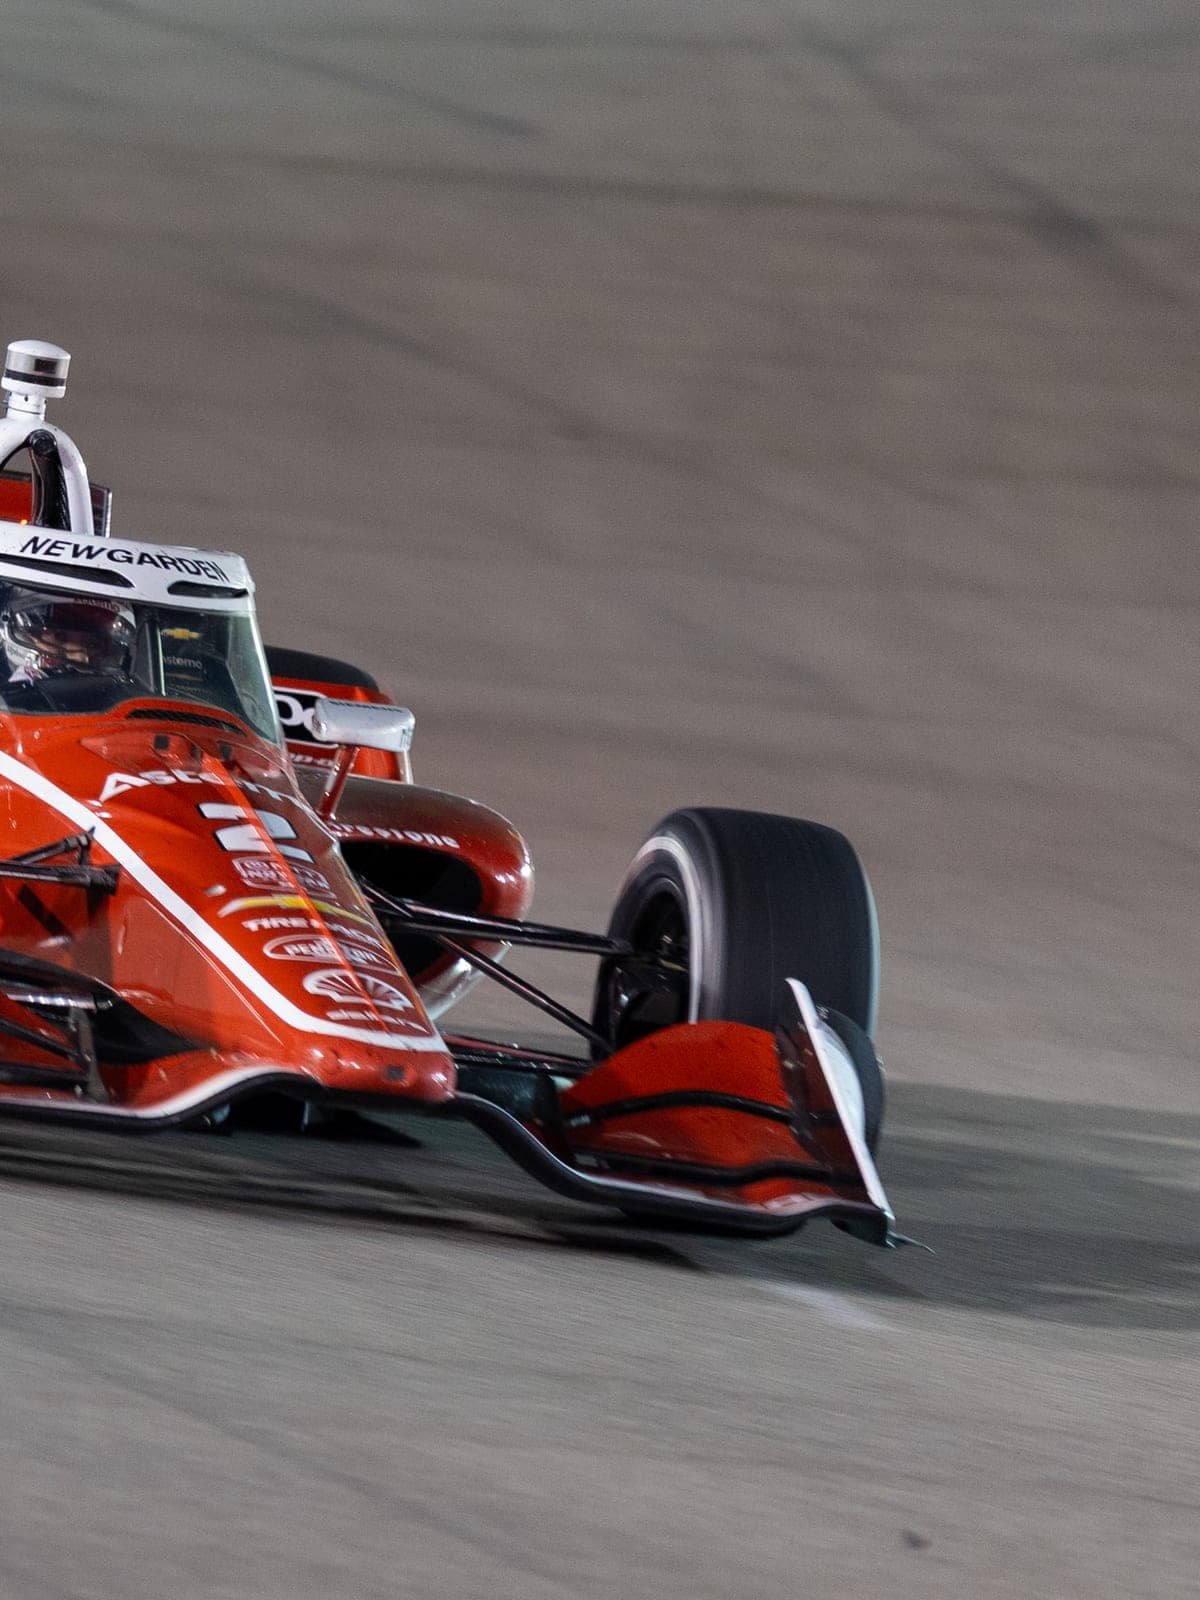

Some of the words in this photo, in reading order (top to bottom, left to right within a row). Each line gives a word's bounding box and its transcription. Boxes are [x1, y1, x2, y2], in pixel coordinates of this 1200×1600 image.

[20, 535, 230, 582] NEWGARDEN
[164, 656, 203, 670] stemo
[331, 822, 460, 849] irestone
